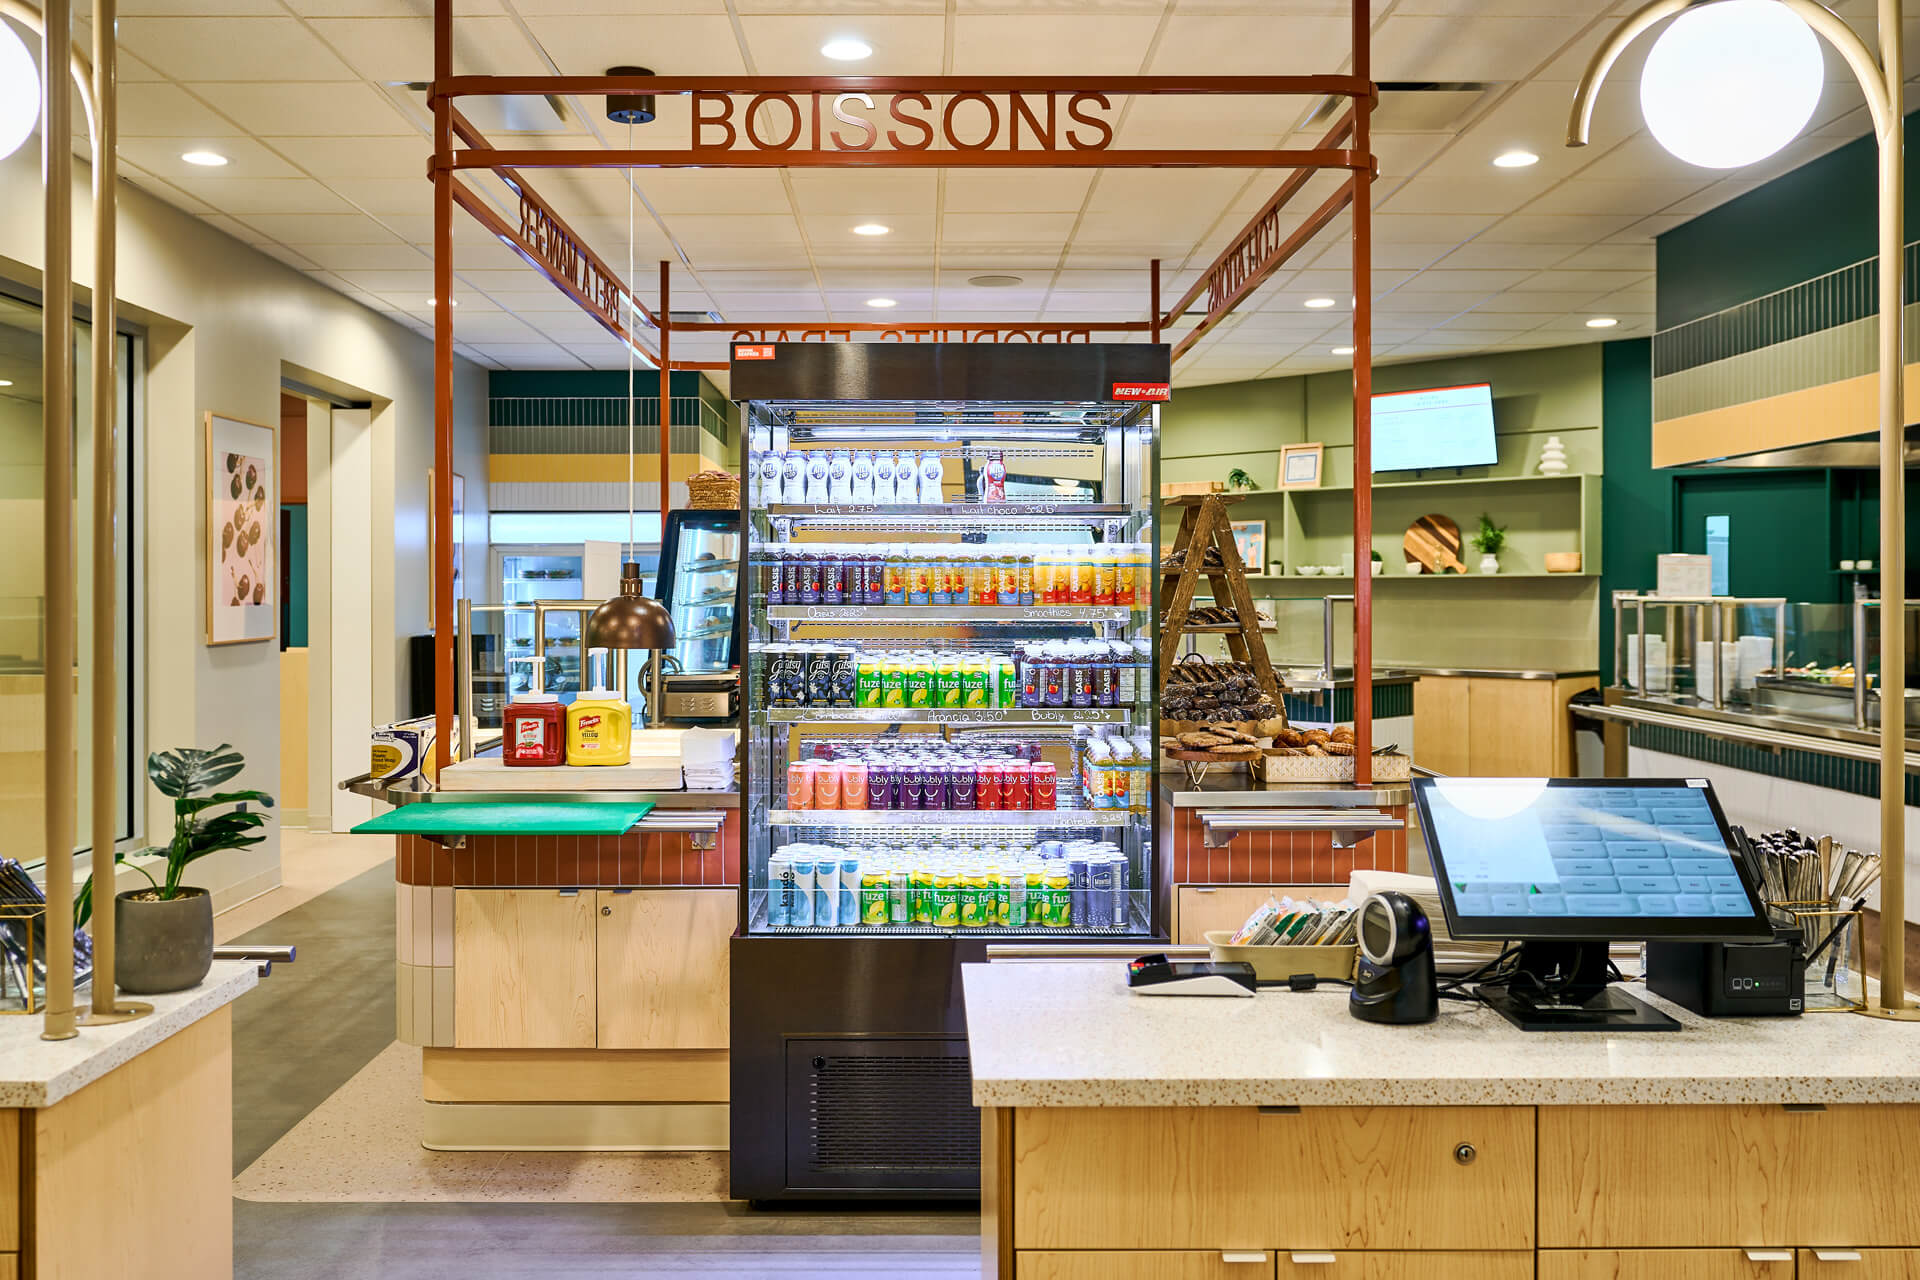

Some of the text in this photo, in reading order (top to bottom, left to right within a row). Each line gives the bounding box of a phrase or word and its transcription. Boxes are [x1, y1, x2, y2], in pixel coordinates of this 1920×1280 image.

[691, 92, 1114, 151] BOISSONS
[814, 504, 842, 514] Lait
[772, 567, 780, 592] OASIS
[788, 566, 796, 592] OASIS
[803, 567, 811, 592] OASIS
[827, 567, 835, 592] OASIS
[1023, 607, 1072, 617] Smoothies
[938, 678, 960, 689] fuze
[1075, 669, 1083, 695] OASIS
[1103, 669, 1111, 695] OASIS
[1031, 709, 1064, 722] Bubly
[952, 775, 974, 784] bubly
[1034, 775, 1056, 784] bubly
[934, 892, 956, 902] fuze
